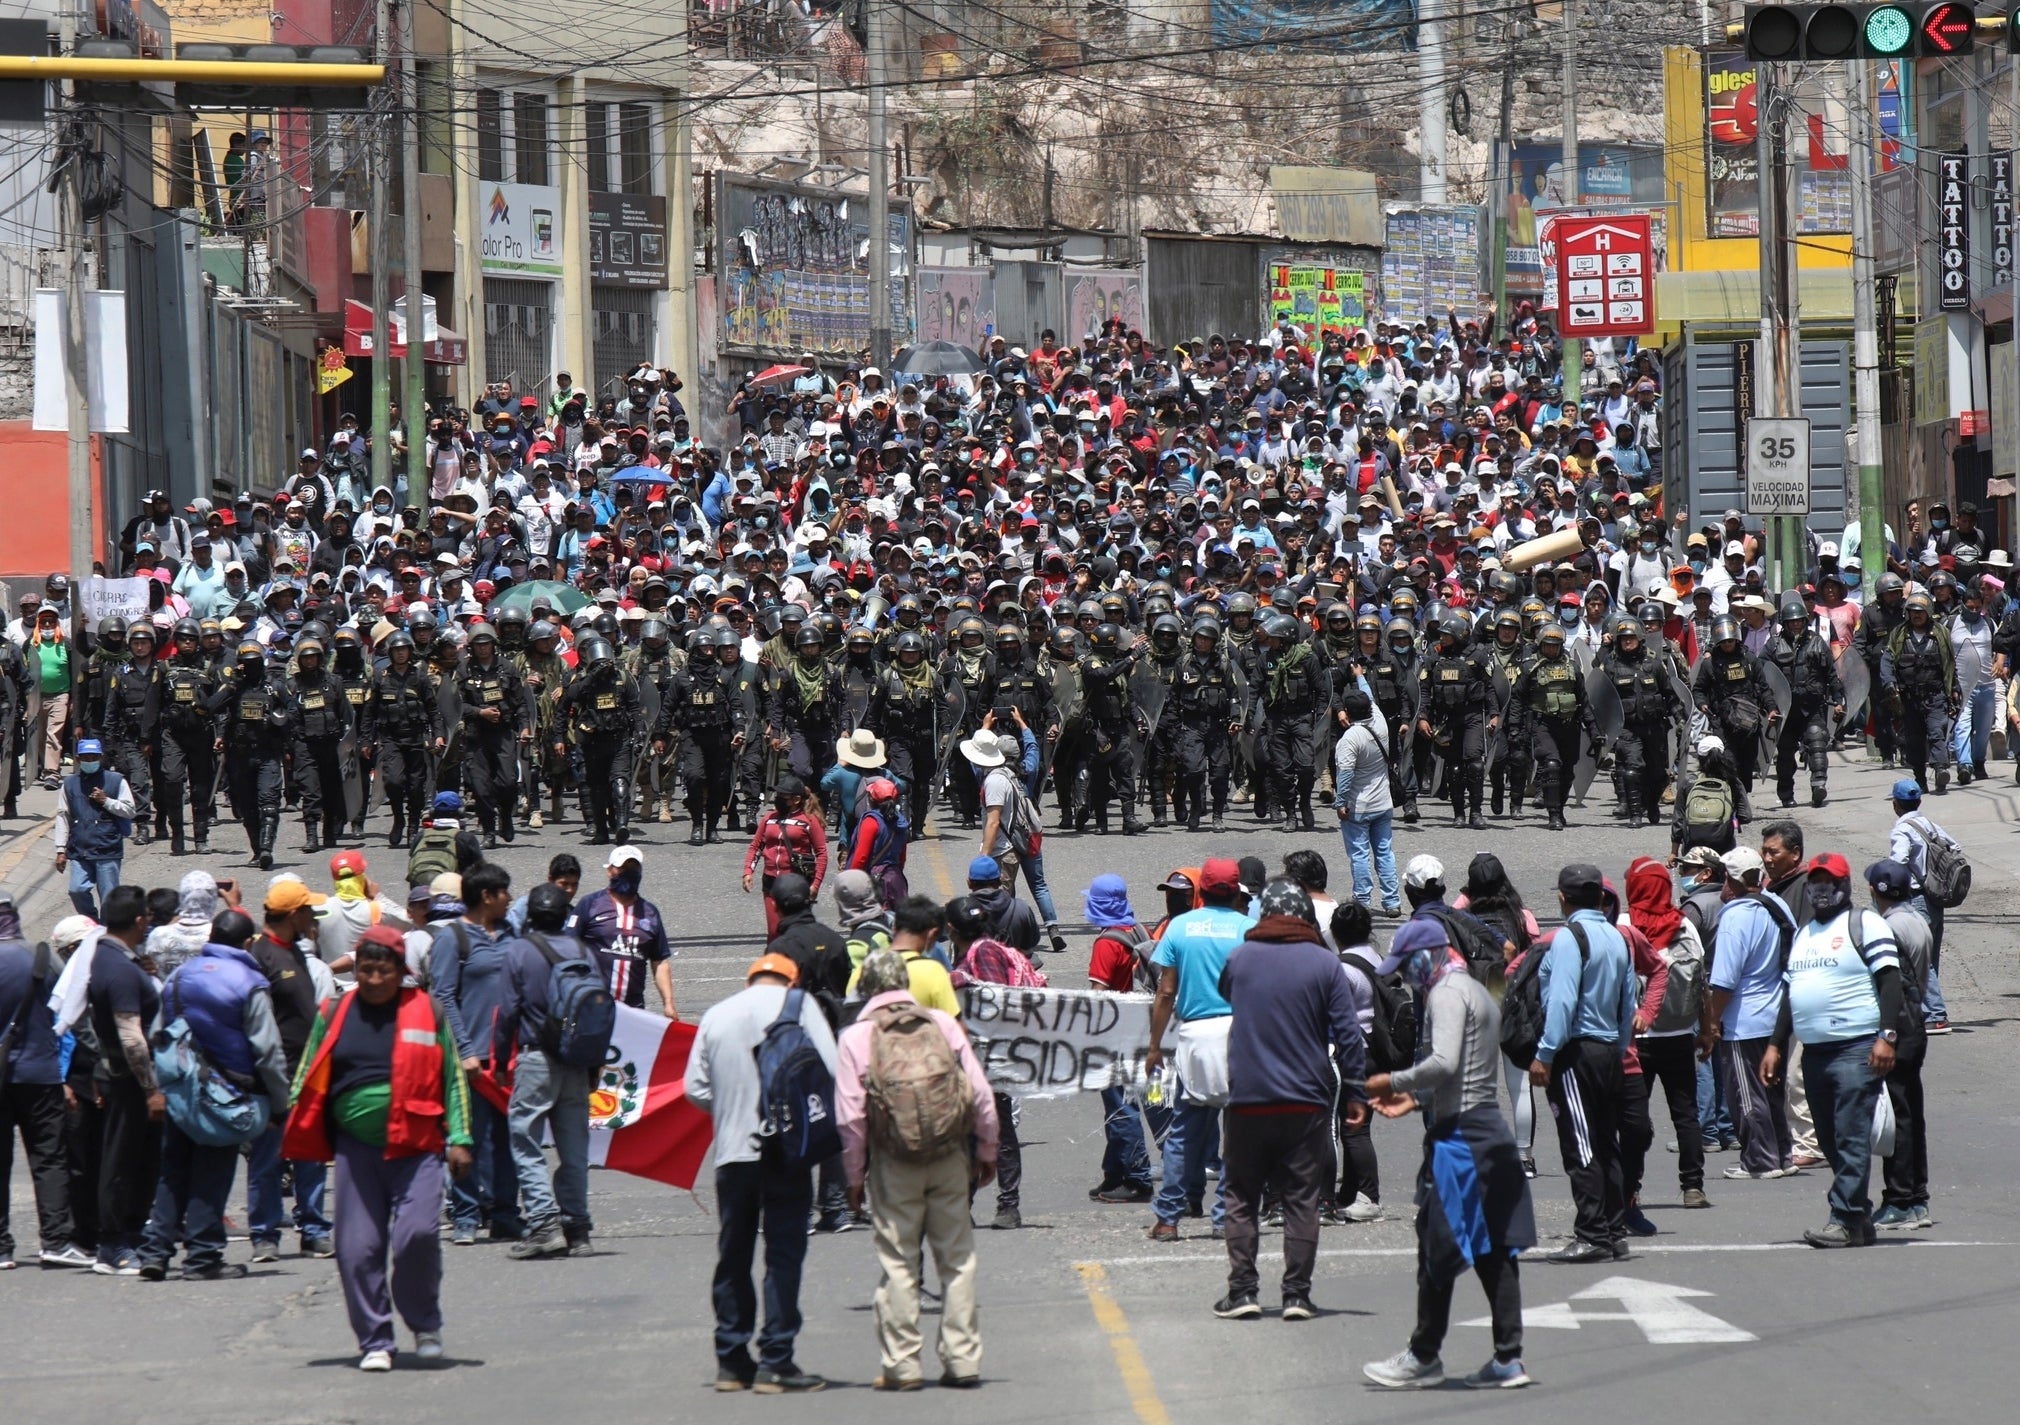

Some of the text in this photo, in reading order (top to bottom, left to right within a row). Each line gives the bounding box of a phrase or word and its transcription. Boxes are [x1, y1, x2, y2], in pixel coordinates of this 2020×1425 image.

[1709, 68, 1757, 94] glesi
[1943, 159, 1964, 291] TATTOO
[481, 233, 522, 259] olor Pro
[1595, 233, 1611, 250] H
[1519, 250, 1531, 261] 907
[1336, 275, 1351, 289] CERRO
[1760, 437, 1796, 460] 35
[1769, 460, 1787, 469] KPH
[1752, 482, 1805, 492] VELOCIDAD
[1751, 493, 1806, 506] MAXIMA
[92, 590, 129, 604] CIERRE
[1791, 956, 1839, 971] mirates
[963, 984, 1120, 1037] IBERTAD
